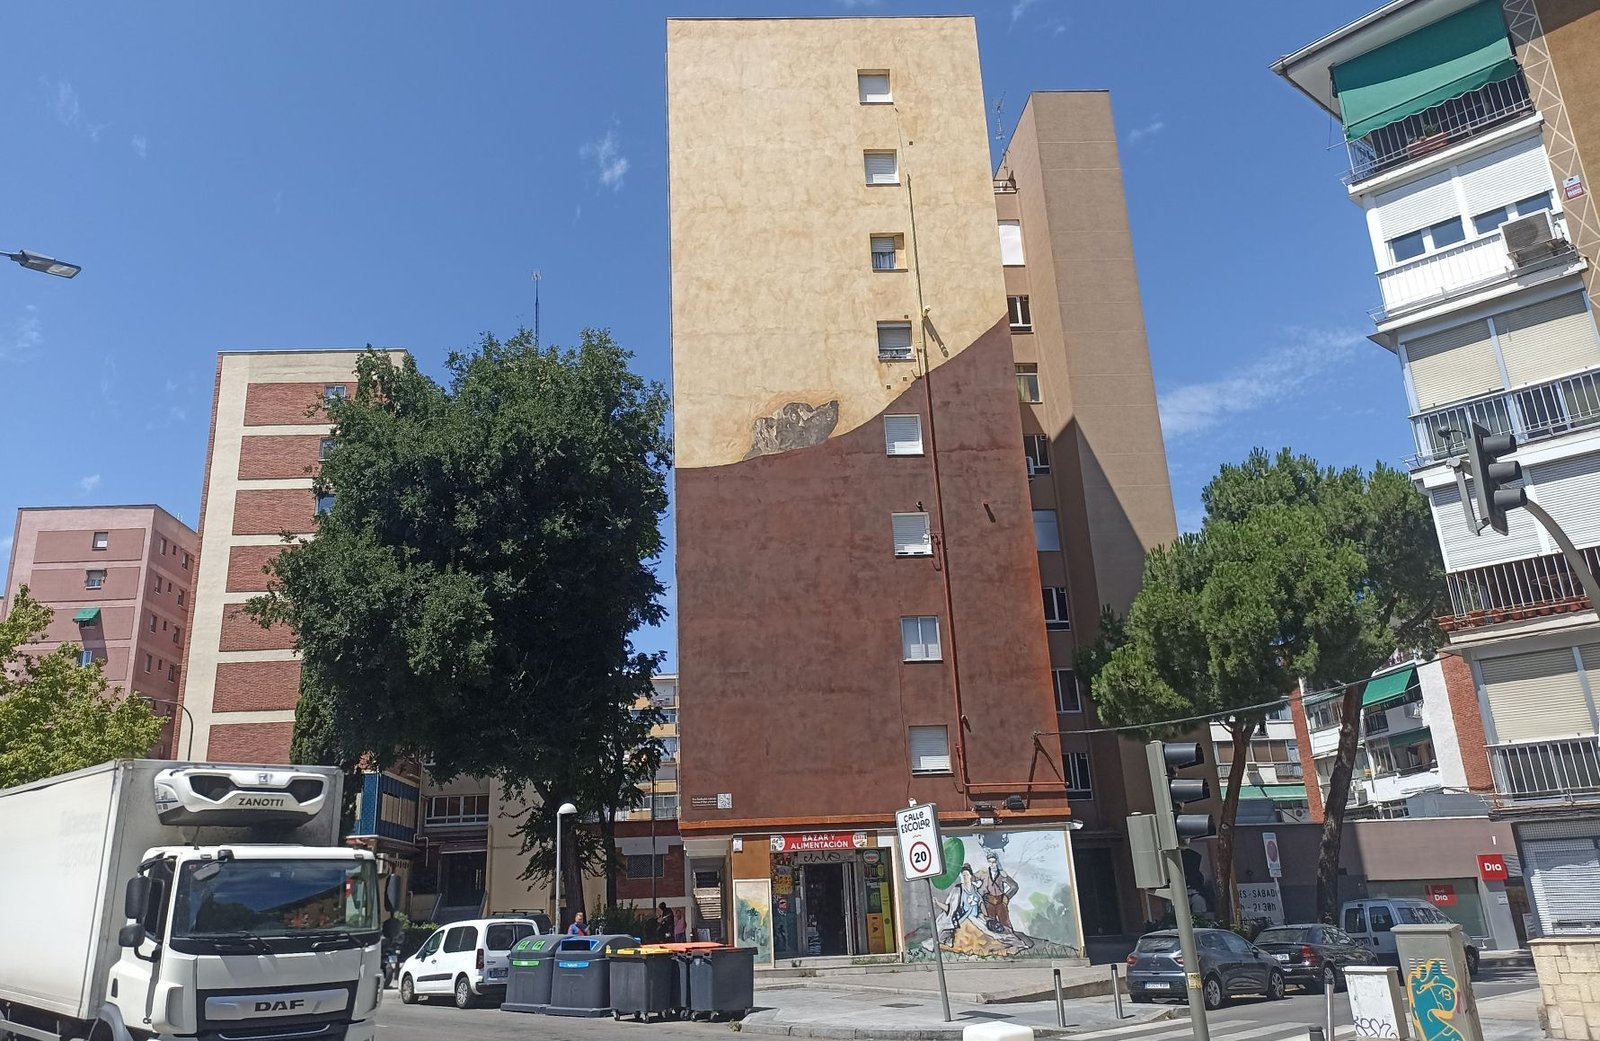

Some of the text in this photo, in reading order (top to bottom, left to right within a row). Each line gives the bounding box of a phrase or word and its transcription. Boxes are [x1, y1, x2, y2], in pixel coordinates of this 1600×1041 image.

[238, 797, 284, 807] ZANOTTI
[901, 818, 931, 834] ESCOLAR
[802, 834, 828, 842] BAZAR
[790, 840, 849, 850] ALIMENTACIÓN
[914, 851, 927, 863] 20
[255, 1000, 304, 1012] DAF
